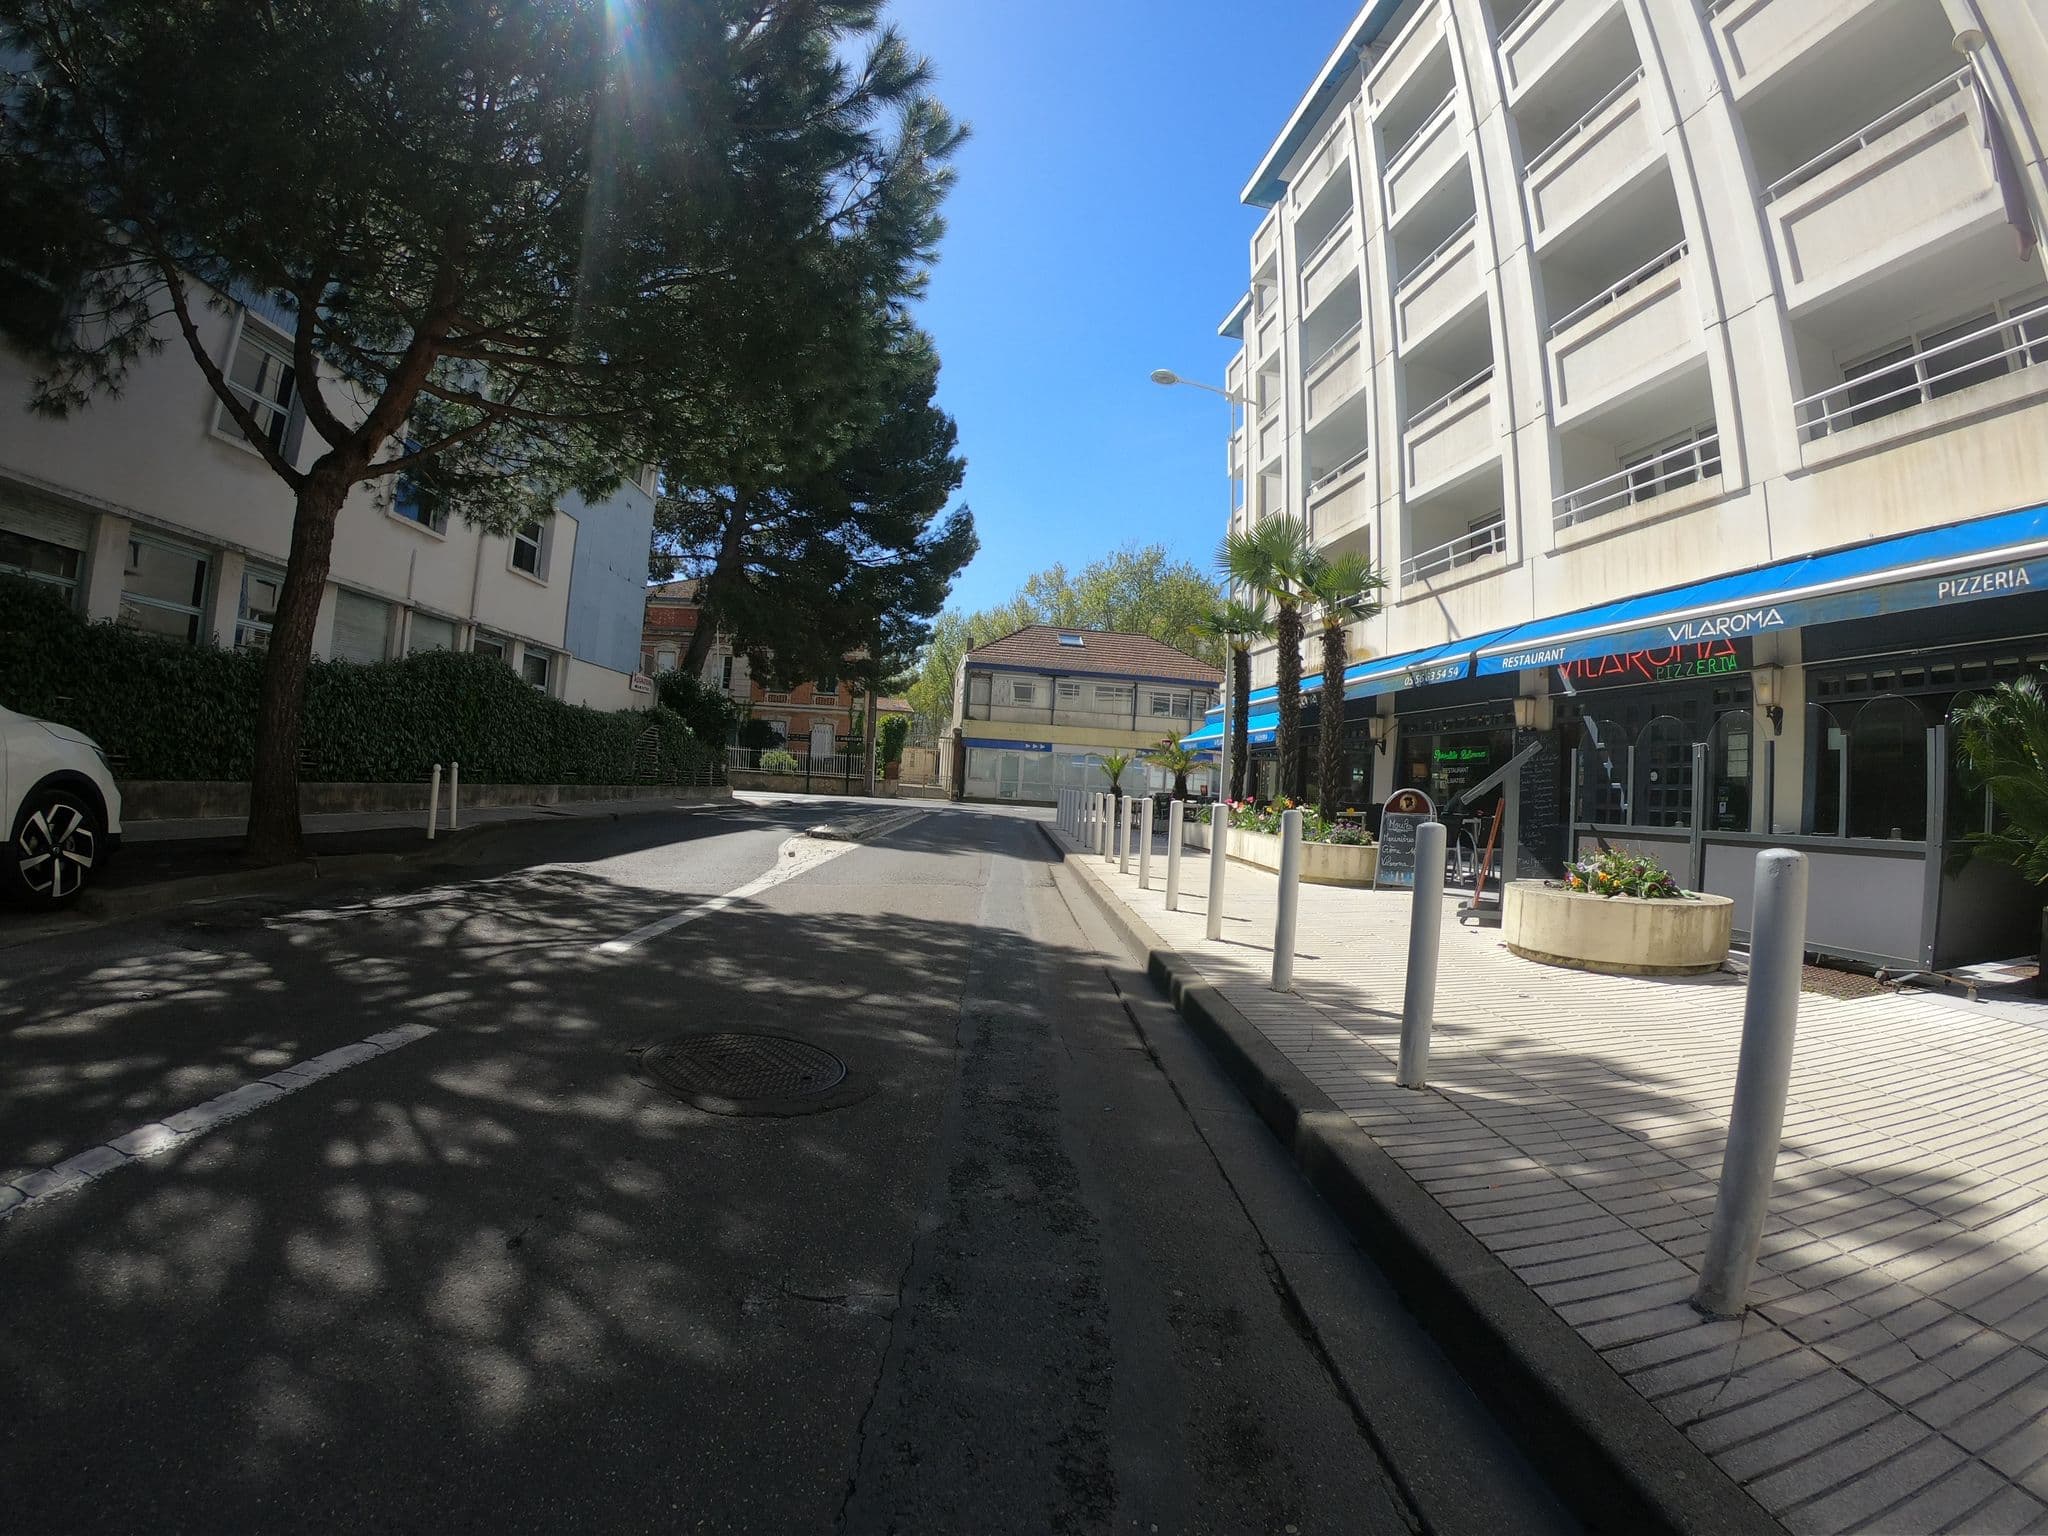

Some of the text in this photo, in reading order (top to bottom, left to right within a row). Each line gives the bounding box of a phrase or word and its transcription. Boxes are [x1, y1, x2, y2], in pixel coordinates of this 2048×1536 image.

[1938, 567, 2031, 600] PIZZERIA
[1667, 608, 1784, 642] VILAROMA
[1502, 648, 1566, 668] RESTAURANT
[1656, 654, 1738, 681] PIZZERIA
[1404, 676, 1414, 686] 05
[1436, 668, 1447, 680] 54
[1447, 666, 1459, 678] 54
